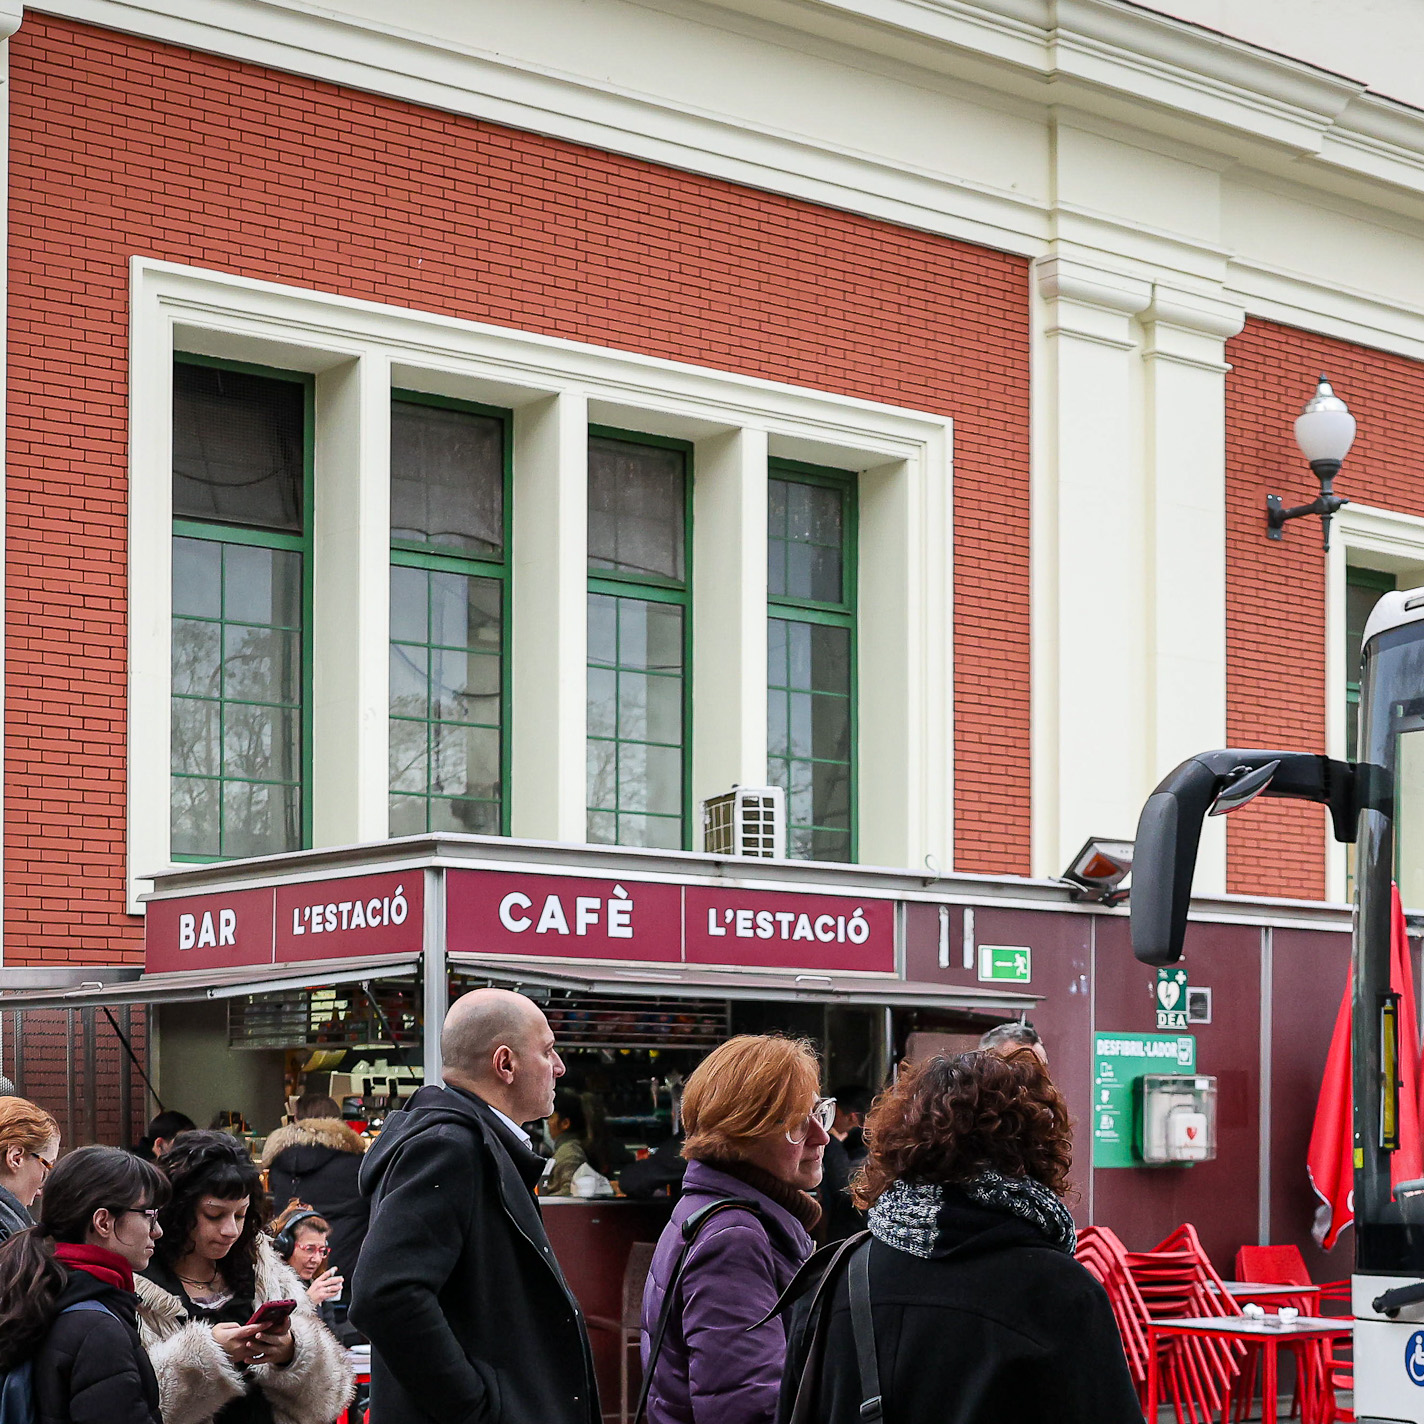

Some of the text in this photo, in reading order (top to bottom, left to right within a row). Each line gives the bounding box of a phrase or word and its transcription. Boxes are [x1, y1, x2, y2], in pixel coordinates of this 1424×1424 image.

[179, 884, 409, 951] BAR L'ESTACIÓ
[498, 883, 871, 945] CAFÈ L'ESTACIÓ
[1157, 1013, 1186, 1026] DEA
